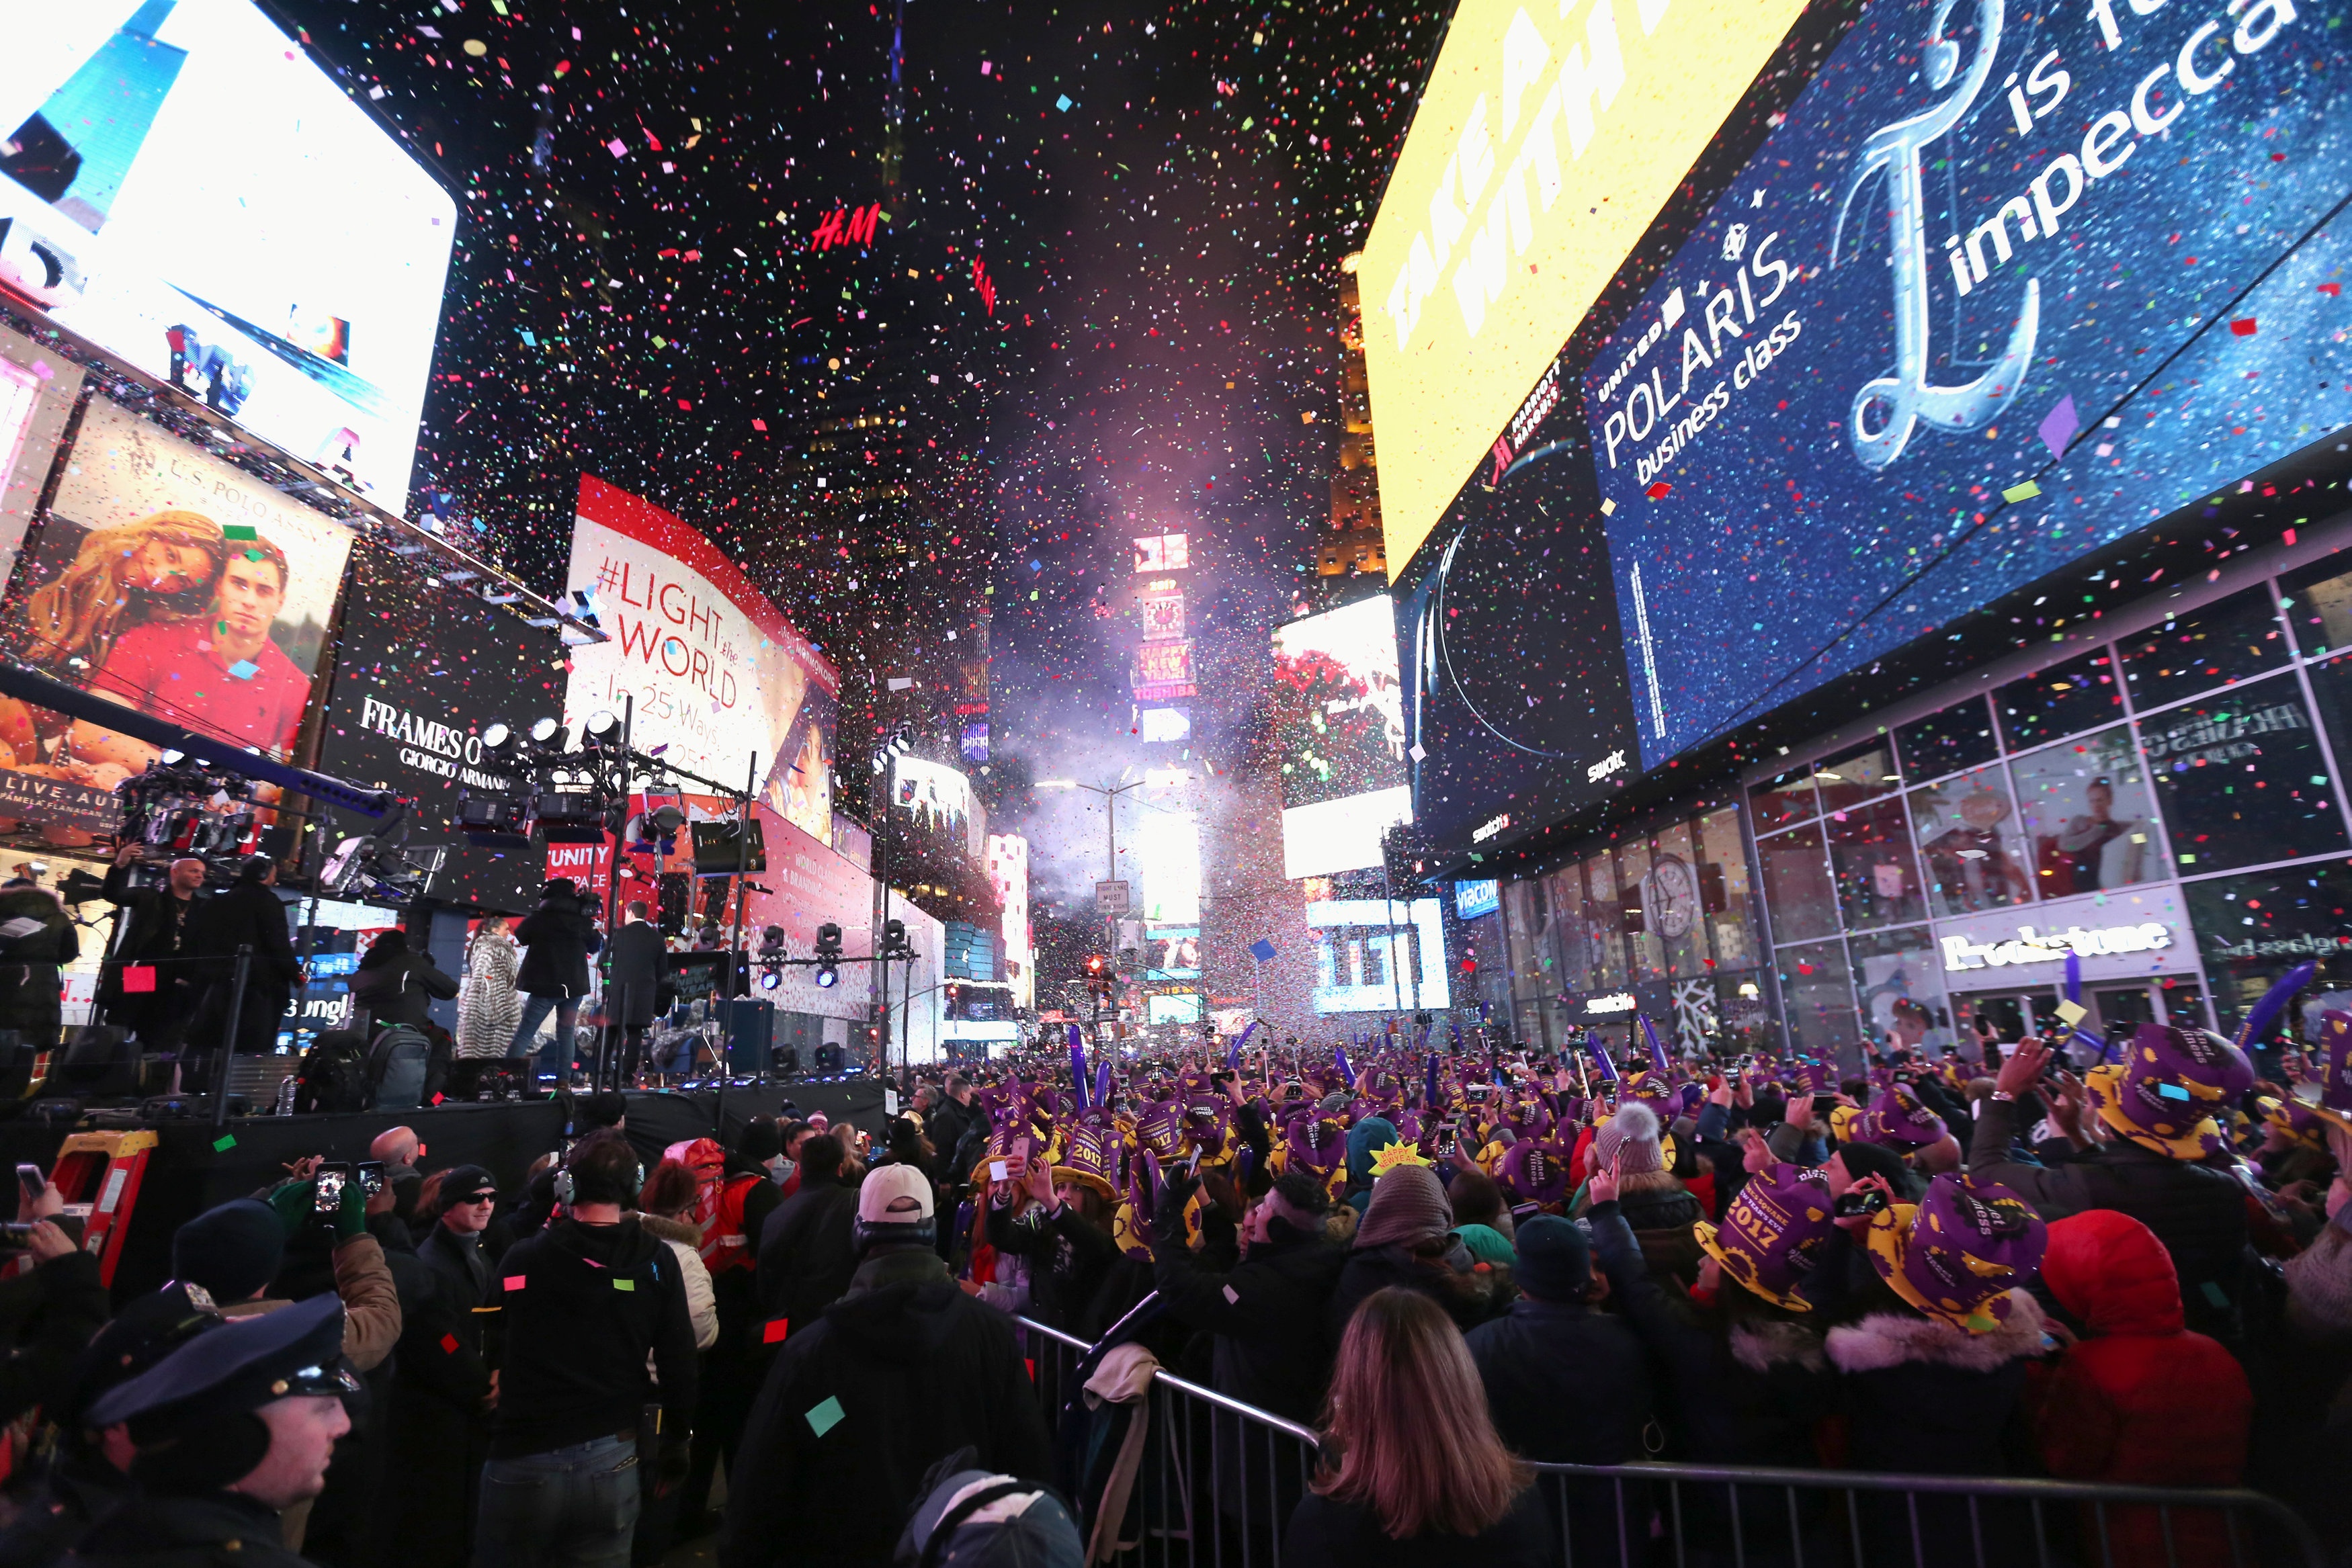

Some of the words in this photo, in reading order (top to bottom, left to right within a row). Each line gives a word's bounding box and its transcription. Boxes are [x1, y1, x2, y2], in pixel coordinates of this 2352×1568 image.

[2003, 49, 2071, 137] is
[811, 202, 882, 253] H&M
[1598, 321, 1663, 403] UNITED
[1603, 231, 1788, 470] POLARIS
[1511, 359, 1561, 433] MARRIOTT
[1636, 380, 1730, 486] business
[1733, 310, 1802, 390] class
[213, 480, 267, 518] POLO
[597, 556, 723, 650] #LIGHT
[618, 613, 737, 709] WORLD
[1140, 644, 1189, 660] HAPPY
[1147, 656, 1181, 670] NEW
[640, 686, 673, 720] 25
[1132, 683, 1198, 700] TOSHIBA
[360, 697, 463, 758] FRAMES
[400, 747, 457, 779] GIORGIO
[1073, 1143, 1102, 1168] 2017
[1380, 1147, 1409, 1160] HAPPY
[1529, 1154, 1538, 1186] fitness
[1534, 1149, 1546, 1180] planet
[1758, 1199, 1790, 1227] SQUARE
[1768, 1219, 1785, 1233] EVE
